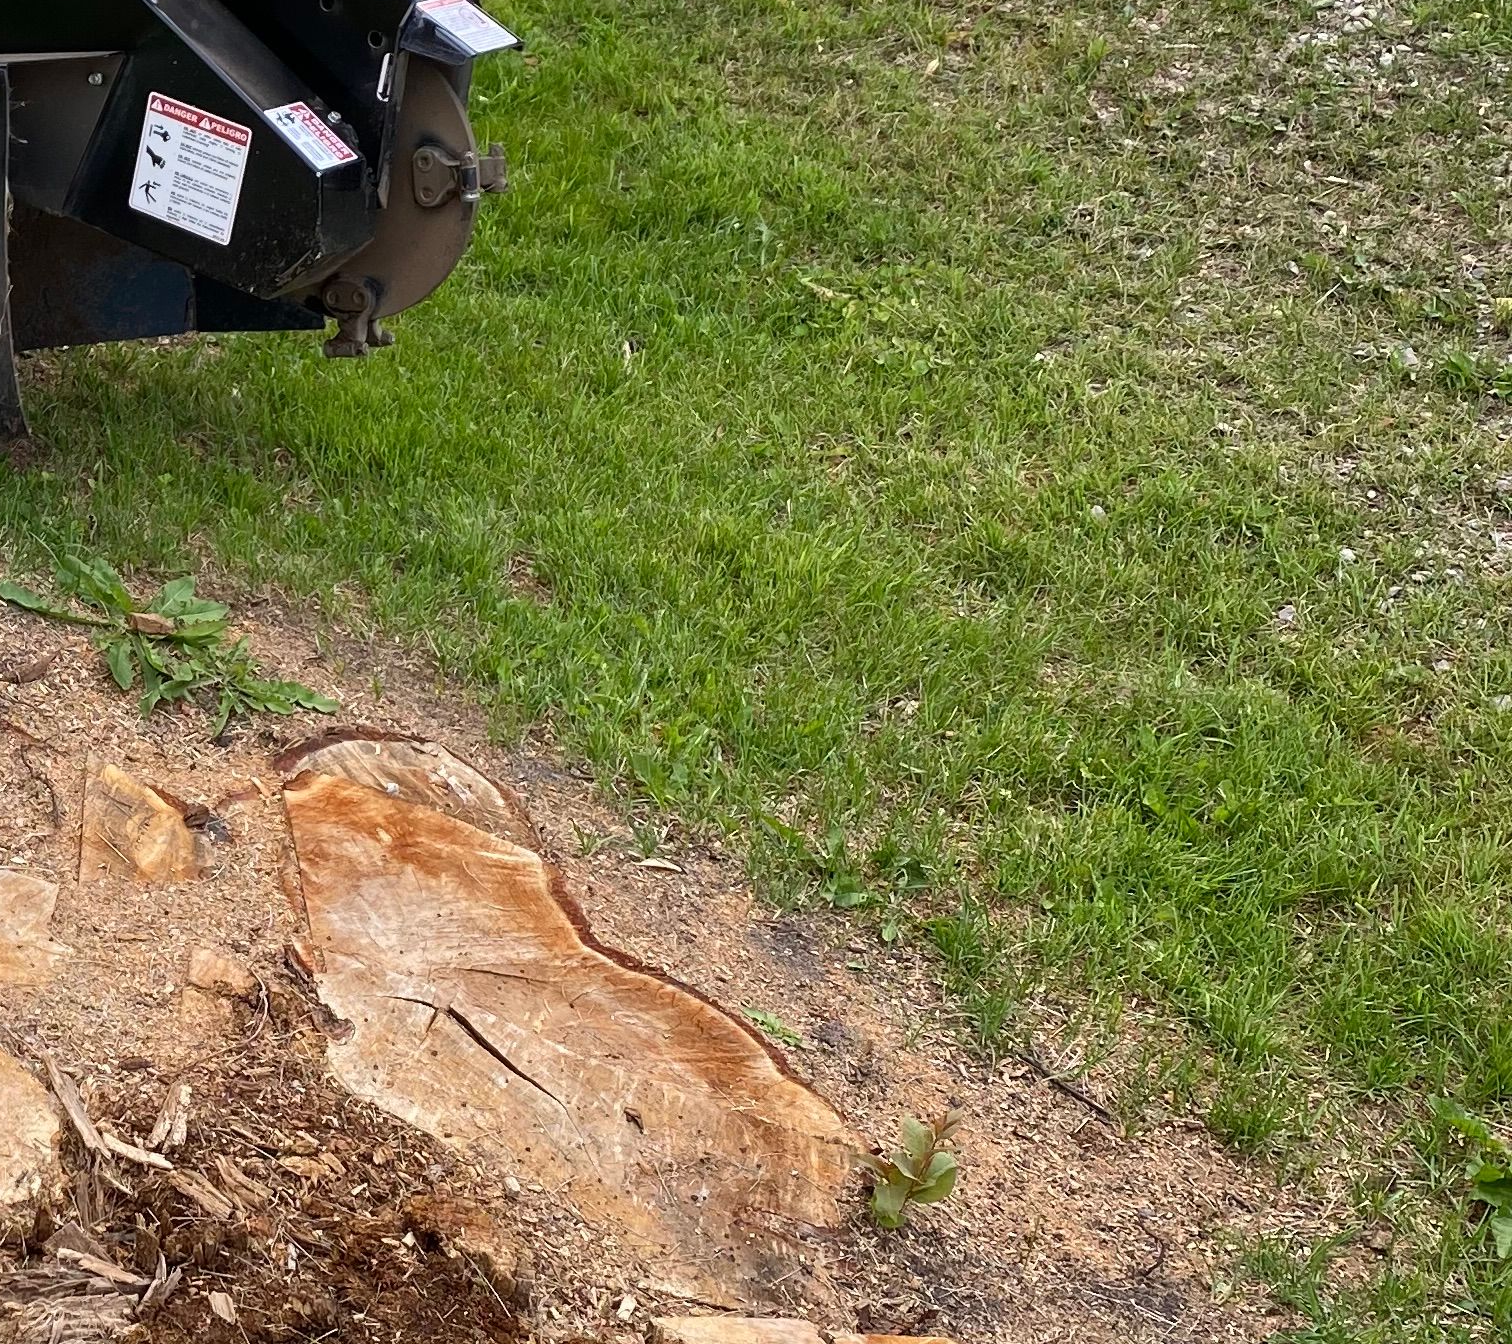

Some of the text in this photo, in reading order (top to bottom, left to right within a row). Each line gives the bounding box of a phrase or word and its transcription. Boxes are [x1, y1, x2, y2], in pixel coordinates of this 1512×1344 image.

[163, 103, 198, 123] DANGER
[211, 122, 248, 141] PELIGRO
[303, 119, 344, 159] PELIGRO
[311, 117, 350, 155] DANGER
